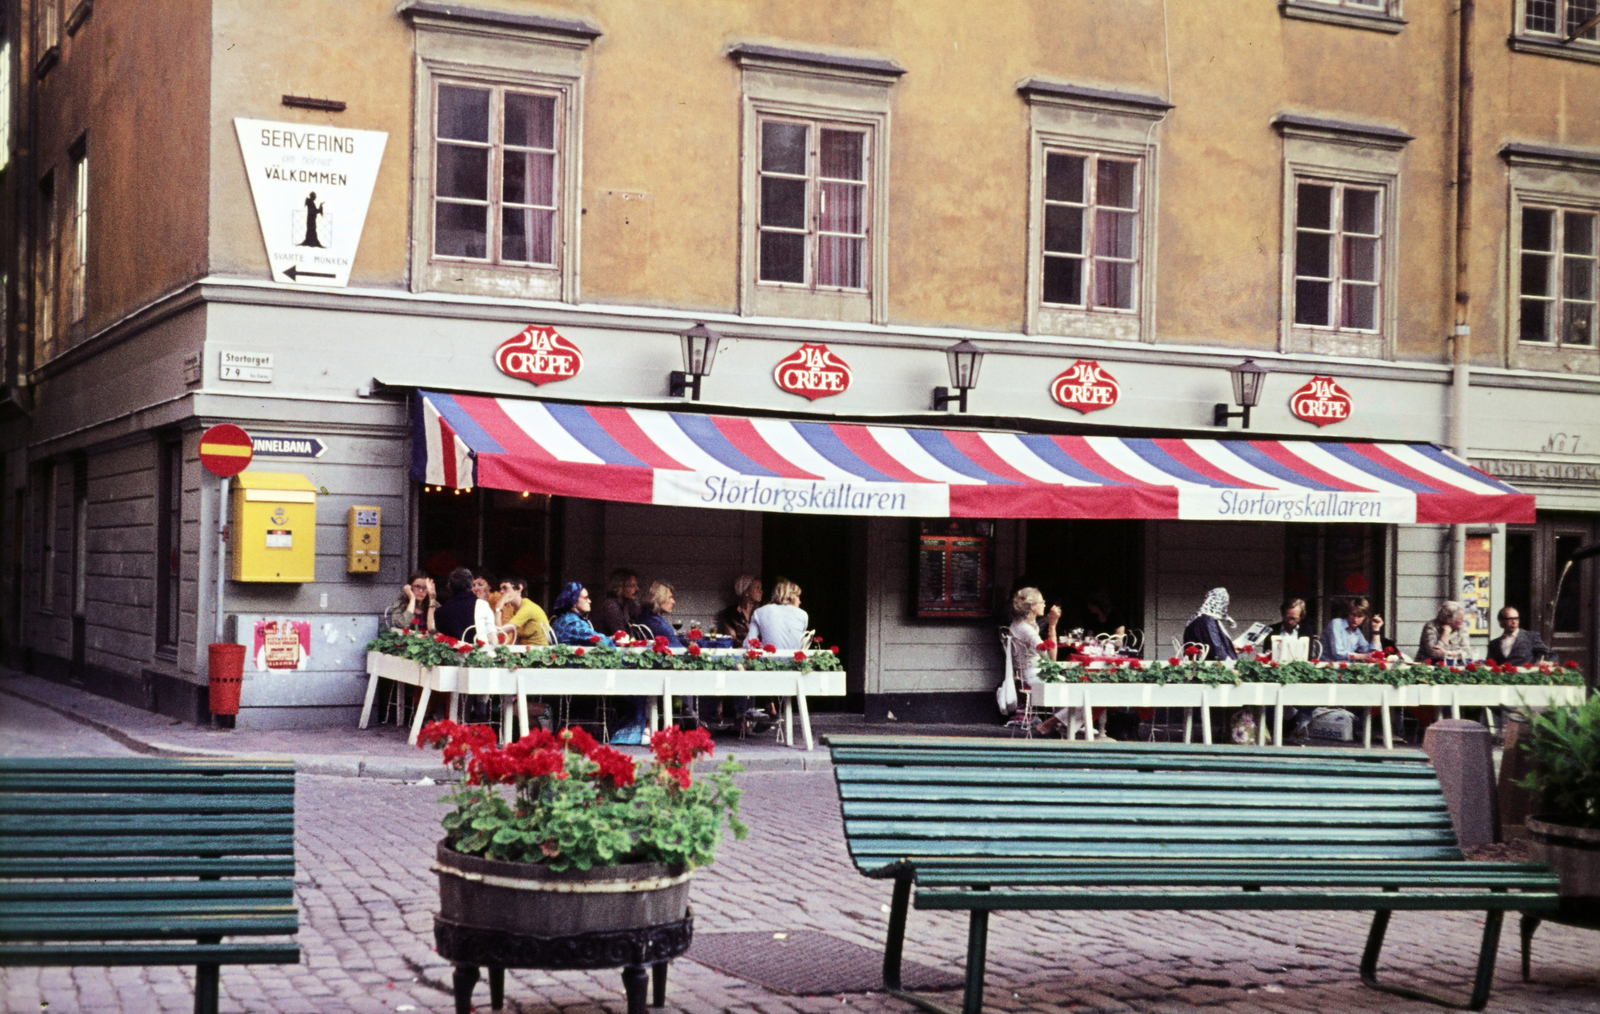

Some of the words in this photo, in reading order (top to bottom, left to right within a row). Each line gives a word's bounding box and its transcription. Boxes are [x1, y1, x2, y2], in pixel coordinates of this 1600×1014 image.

[261, 129, 354, 154] SERVERING
[264, 164, 347, 186] VÄLKOMMEN
[274, 252, 305, 262] SVARTE
[313, 256, 348, 266] MUNKEN
[530, 330, 553, 351] LA
[225, 352, 270, 367] Stortorget
[805, 348, 826, 368] LA
[235, 368, 241, 378] 9
[1078, 364, 1098, 383] LA
[1315, 380, 1333, 398] LA
[252, 439, 312, 454] UNNELBANA
[1572, 434, 1582, 453] 7
[701, 475, 906, 512] Stortorgskällaren
[1218, 490, 1382, 520] Stortorgskällaren
